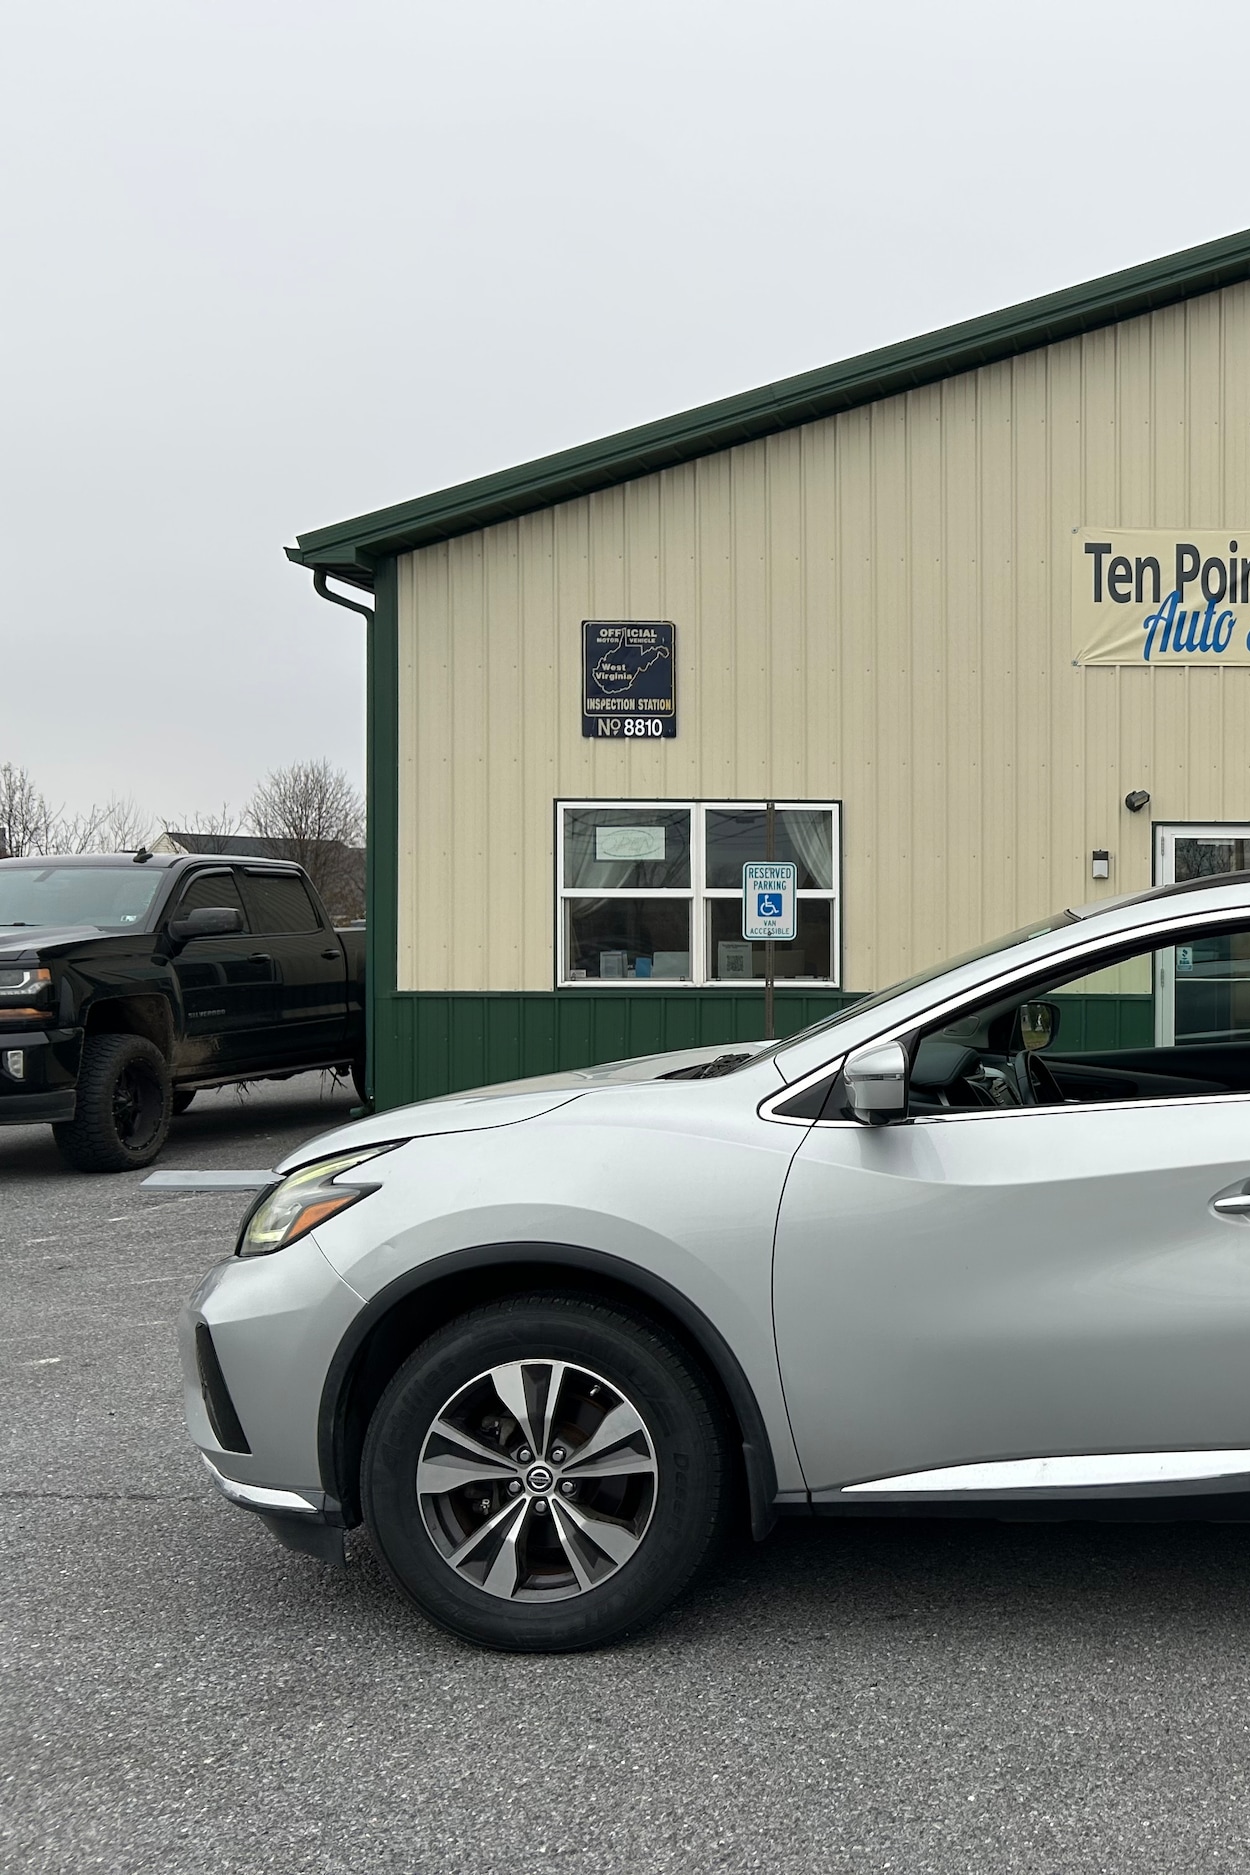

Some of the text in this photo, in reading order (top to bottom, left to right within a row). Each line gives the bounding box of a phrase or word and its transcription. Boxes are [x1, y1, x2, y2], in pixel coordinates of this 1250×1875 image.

[1084, 542, 1161, 604] Ten
[1143, 590, 1236, 661] Auto
[599, 629, 657, 638] OFFICIAL
[601, 663, 626, 671] West
[595, 672, 632, 681] Virginia
[587, 698, 671, 710] INSPECTION STATION
[624, 718, 663, 736] 8810
[749, 867, 792, 879] RESERVED
[753, 880, 787, 891] PARKING
